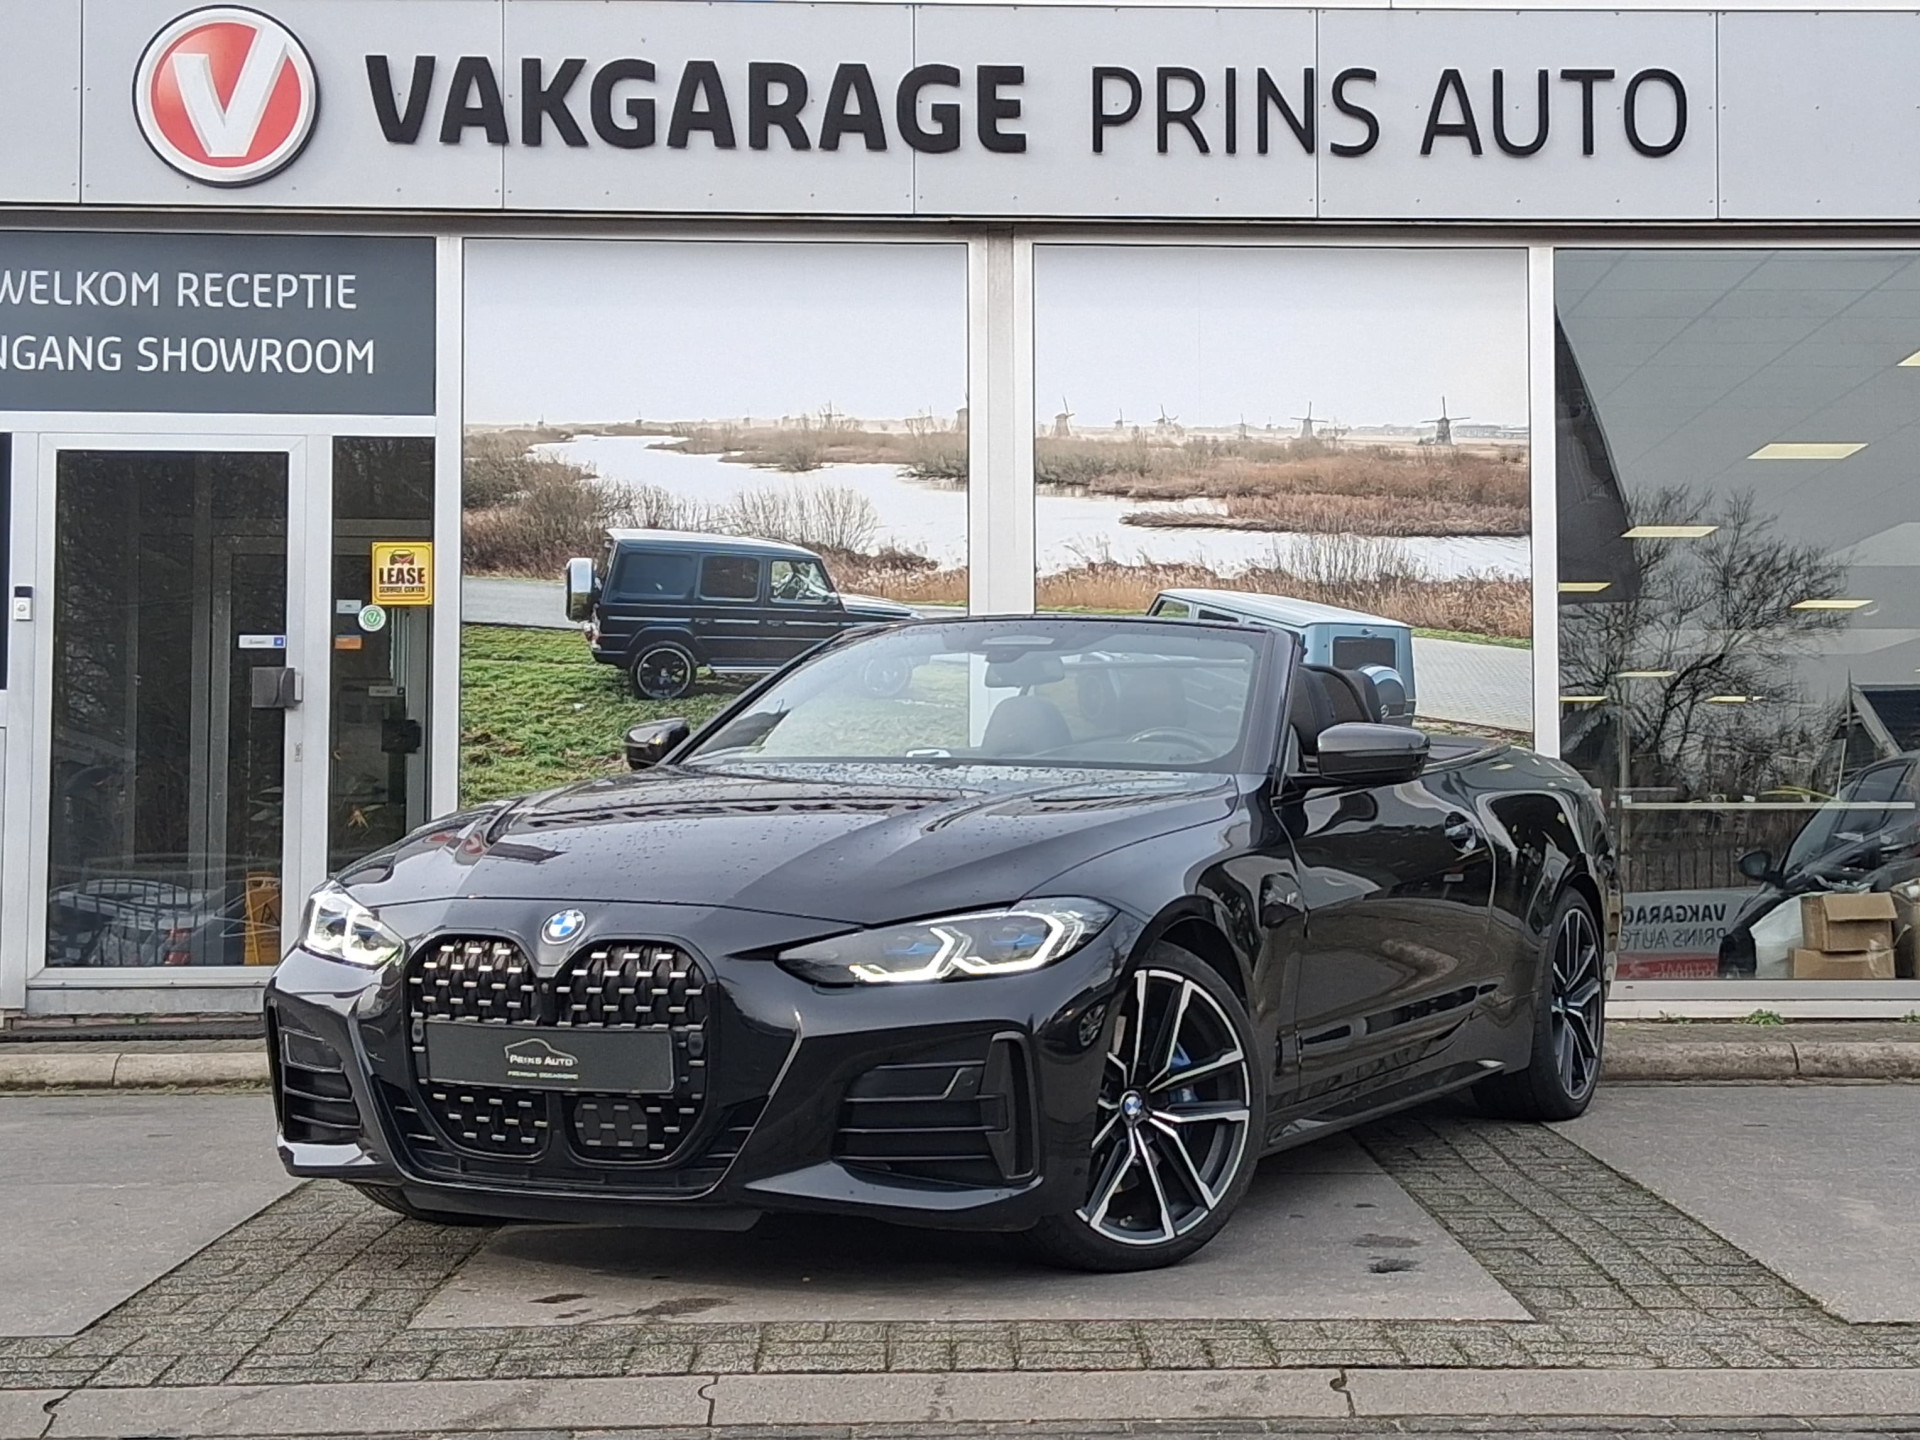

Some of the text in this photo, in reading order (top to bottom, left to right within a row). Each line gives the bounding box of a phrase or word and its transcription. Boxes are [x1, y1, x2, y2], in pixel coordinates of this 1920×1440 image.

[365, 54, 1688, 158] VAKGARAGE PRINS AUTO
[0, 270, 357, 309] WELKOM RECEPTIE
[0, 334, 374, 374] GANG SHOWROOM
[379, 567, 425, 585] LEASE
[544, 1056, 573, 1066] AUTO
